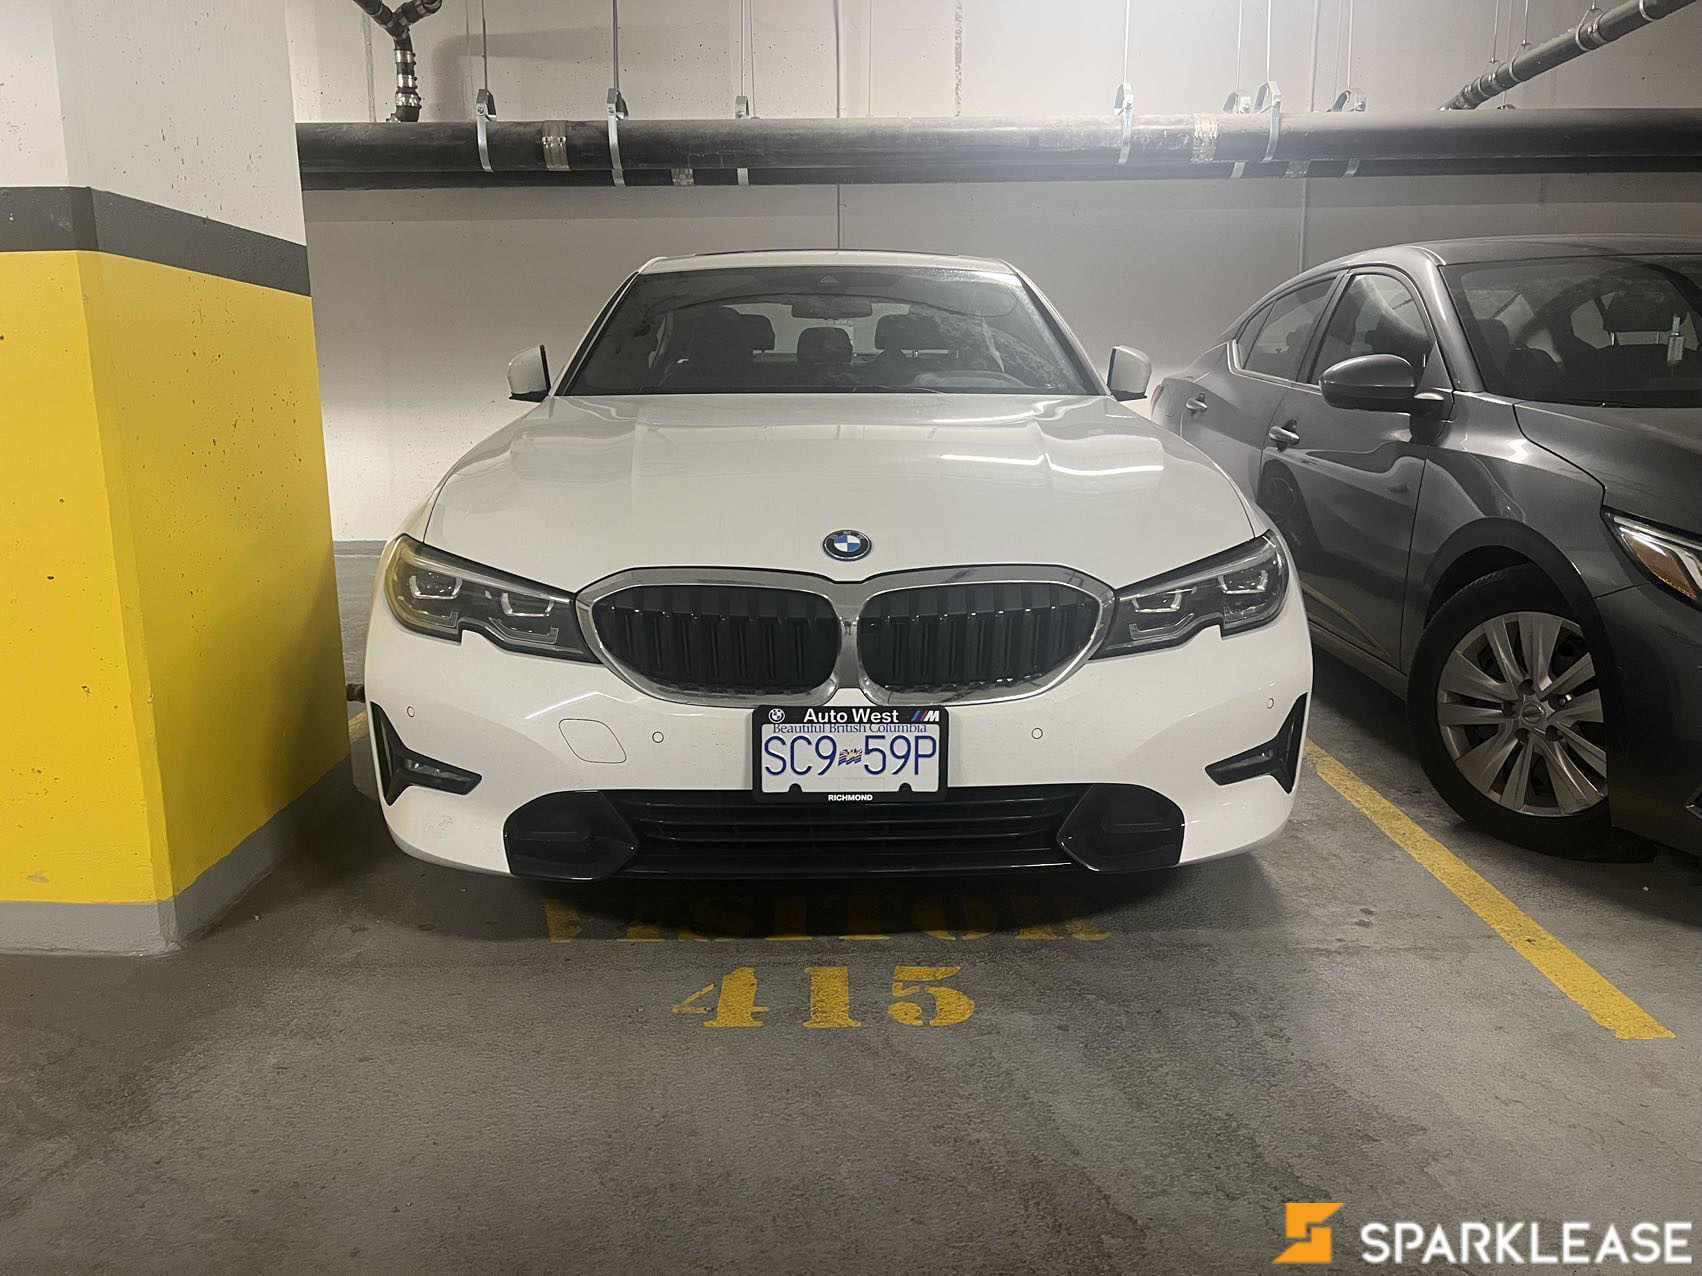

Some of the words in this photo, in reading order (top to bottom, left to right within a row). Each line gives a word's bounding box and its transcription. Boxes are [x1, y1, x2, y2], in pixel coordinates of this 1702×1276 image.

[803, 708, 848, 723] Auto
[851, 708, 899, 723] West
[829, 723, 867, 734] British
[764, 735, 838, 776] SC9
[863, 735, 937, 776] 59P
[828, 794, 874, 802] RICHMOND
[672, 966, 976, 1029] 415
